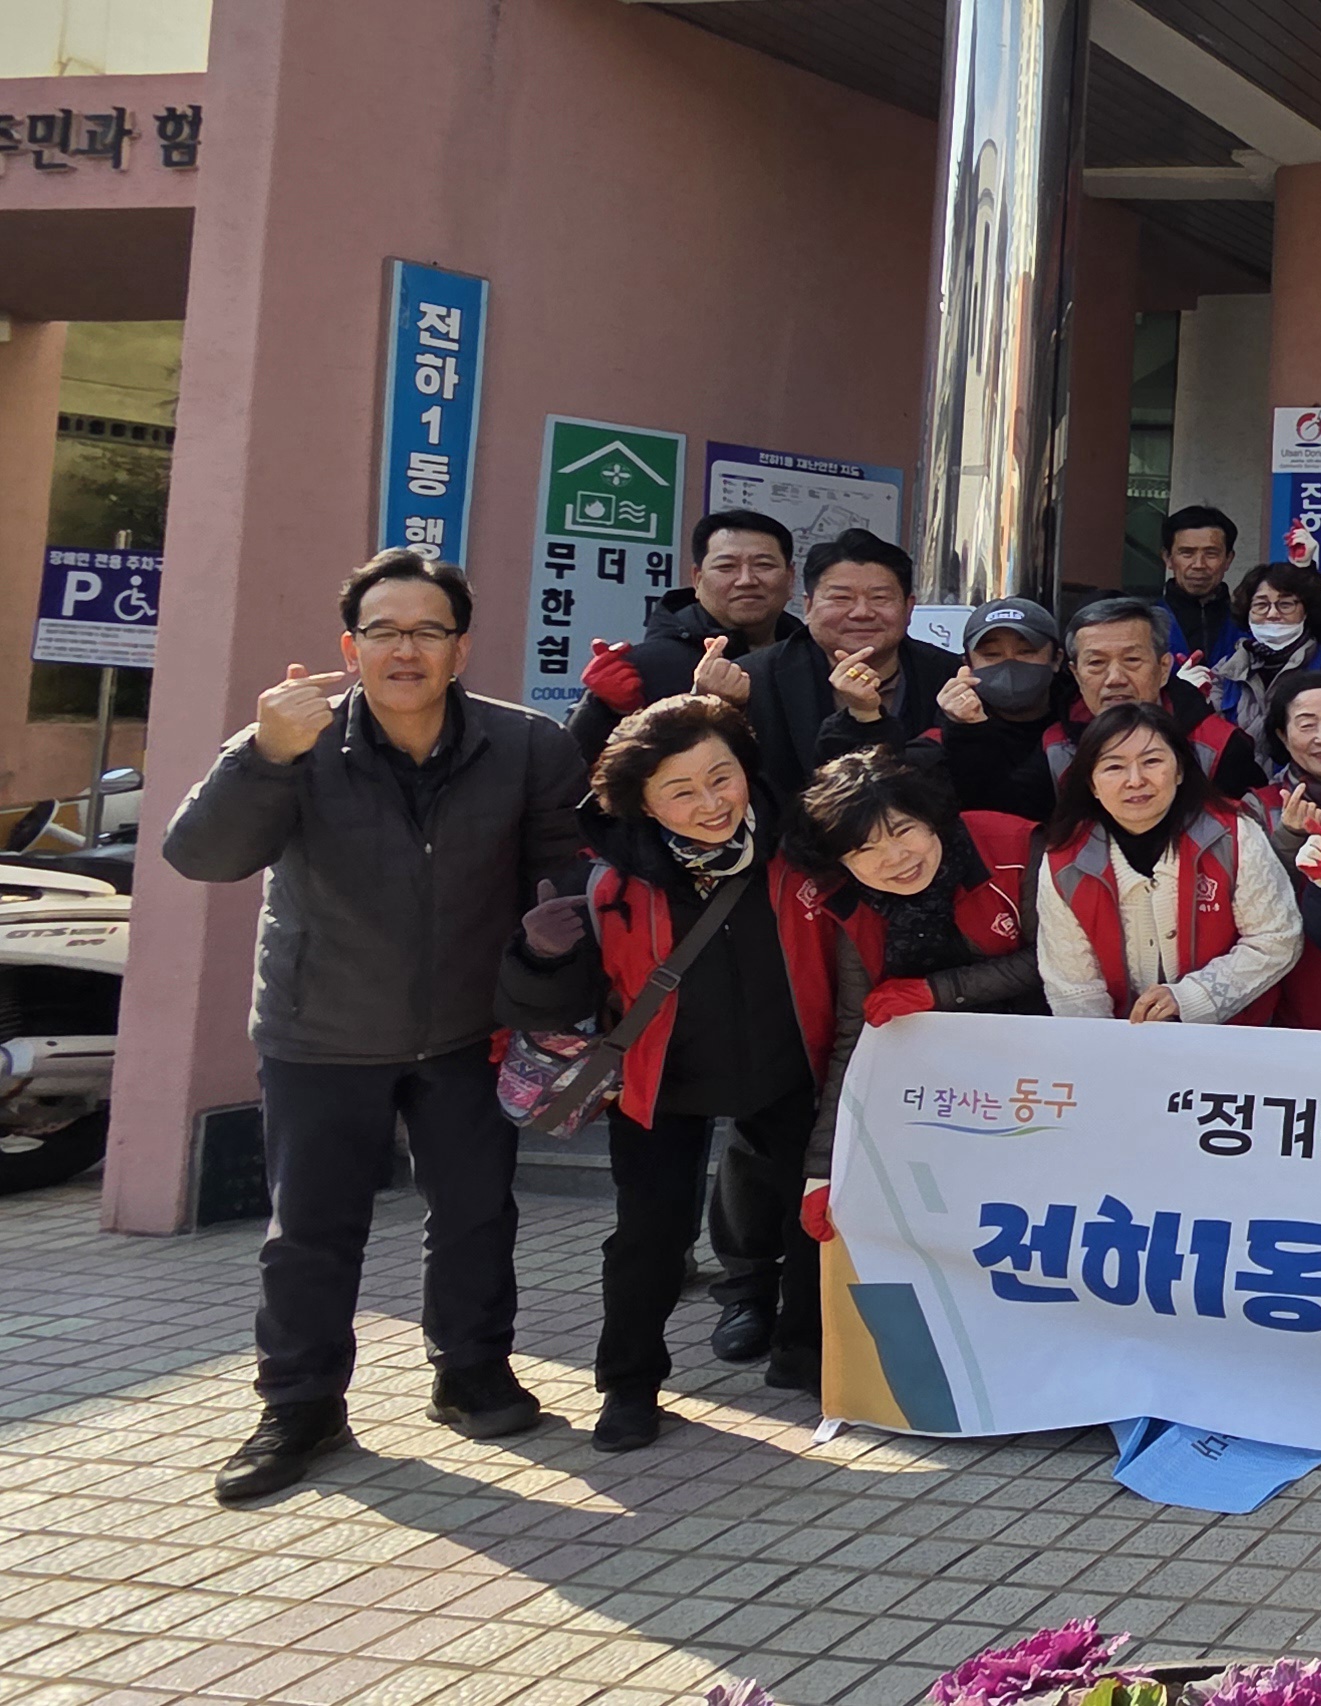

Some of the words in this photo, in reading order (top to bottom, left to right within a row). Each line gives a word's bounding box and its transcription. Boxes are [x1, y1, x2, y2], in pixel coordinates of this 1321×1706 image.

[406, 301, 462, 497] 전하1동
[759, 452, 794, 468] 전하1동
[840, 464, 860, 477] 지도
[1280, 449, 1303, 458] Ulsan
[62, 571, 102, 616] P
[903, 1085, 925, 1111] 더
[933, 1087, 1003, 1120] 잘사는
[1008, 1078, 1077, 1123] 동구
